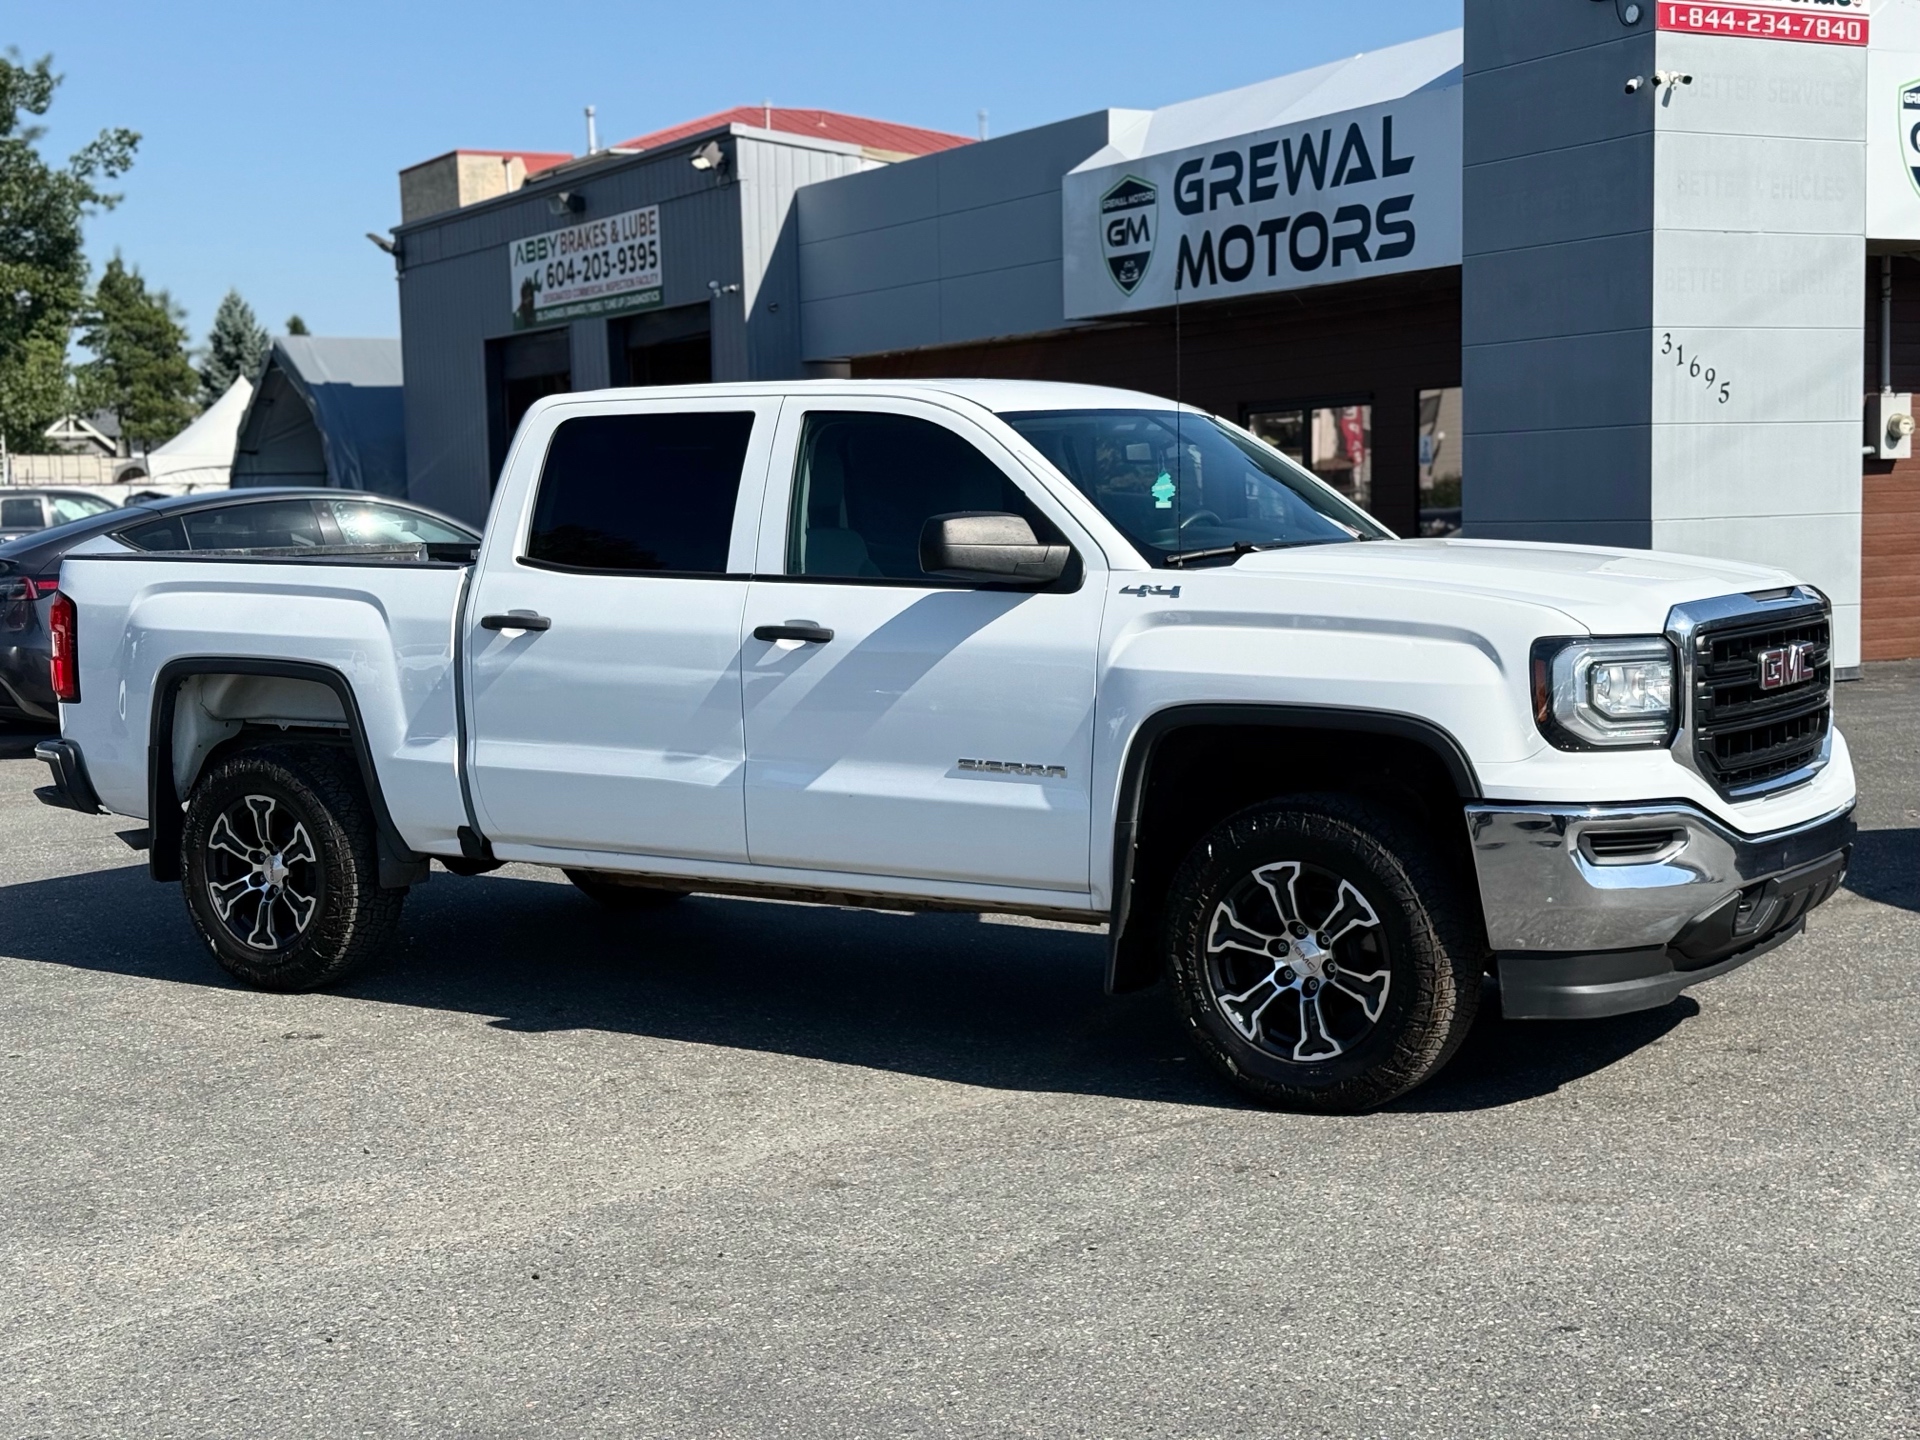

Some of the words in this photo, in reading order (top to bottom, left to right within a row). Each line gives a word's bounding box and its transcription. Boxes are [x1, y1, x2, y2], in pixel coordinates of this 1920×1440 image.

[1669, 6, 1861, 41] 1-844-234-7840
[1174, 115, 1415, 216] GREWAL
[514, 233, 559, 267] ABBY
[560, 222, 608, 256] BRAKES
[610, 219, 619, 244] &
[622, 209, 656, 241] LUBE
[1106, 213, 1150, 248] GM
[1174, 194, 1415, 291] MOTORS
[546, 240, 658, 290] 604-203-9395
[1661, 332, 1730, 404] 31695
[1757, 640, 1814, 690] GMC
[958, 758, 1068, 779] SIERRA
[1294, 946, 1316, 971] GMC
